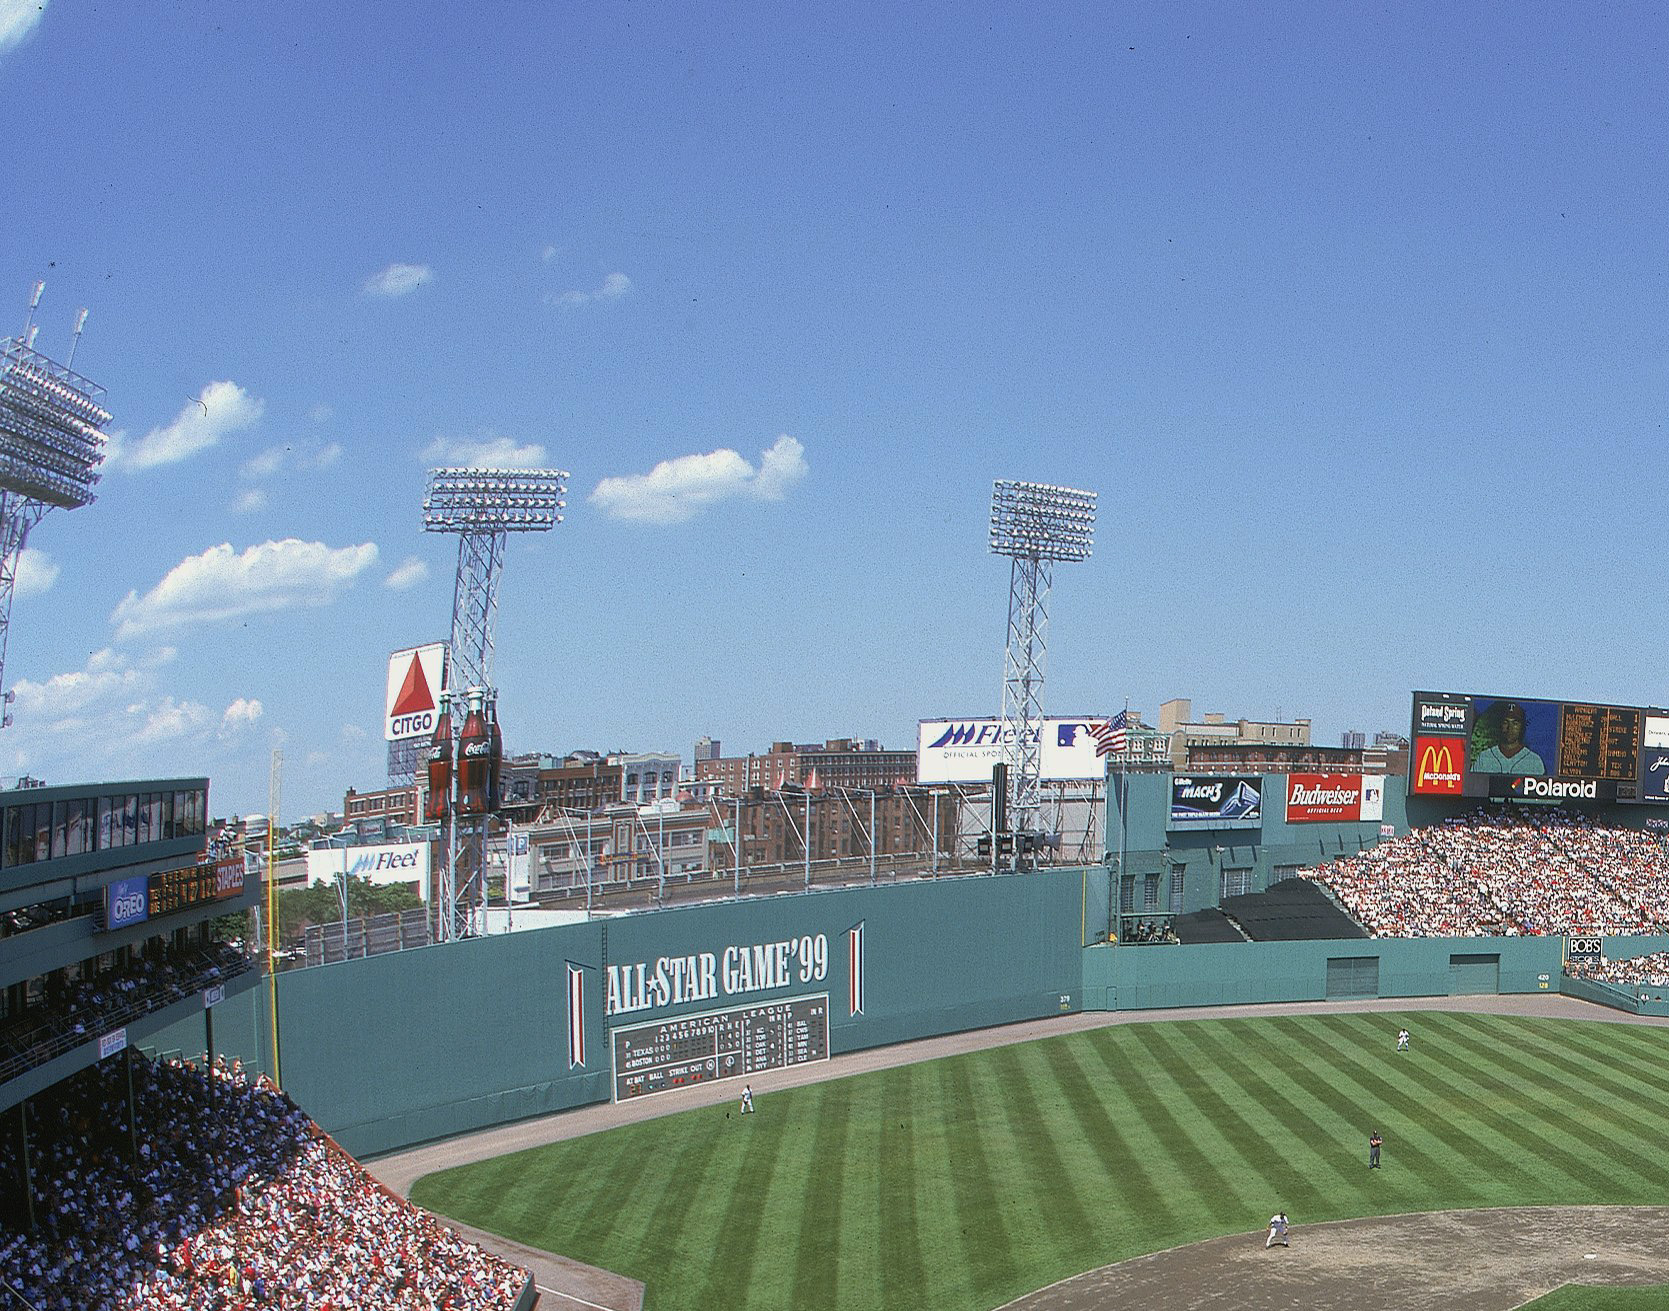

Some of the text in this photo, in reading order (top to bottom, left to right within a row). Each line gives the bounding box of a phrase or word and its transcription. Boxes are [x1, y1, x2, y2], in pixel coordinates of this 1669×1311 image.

[1443, 706, 1465, 722] Spring
[392, 713, 432, 735] CITGO
[943, 751, 978, 759] OFFICIAL
[1423, 772, 1461, 781] McDonald's
[1181, 783, 1223, 802] MACH3
[1523, 777, 1597, 798] Polaroid
[376, 849, 419, 871] Fleet
[217, 863, 244, 892] STAPLES
[114, 893, 144, 920] OREO
[1571, 939, 1600, 953] BOB'S
[723, 941, 791, 994] GAME
[660, 1004, 791, 1033] AMERICAN LEAGUE
[655, 1026, 715, 1043] 1 2 3 4 5 6 7 8 9 10
[633, 1046, 654, 1057] TEXAS
[631, 1057, 653, 1067] BOSTON
[626, 1075, 645, 1085] AT BAT
[649, 1063, 703, 1080] BALL STRIKE OUT
